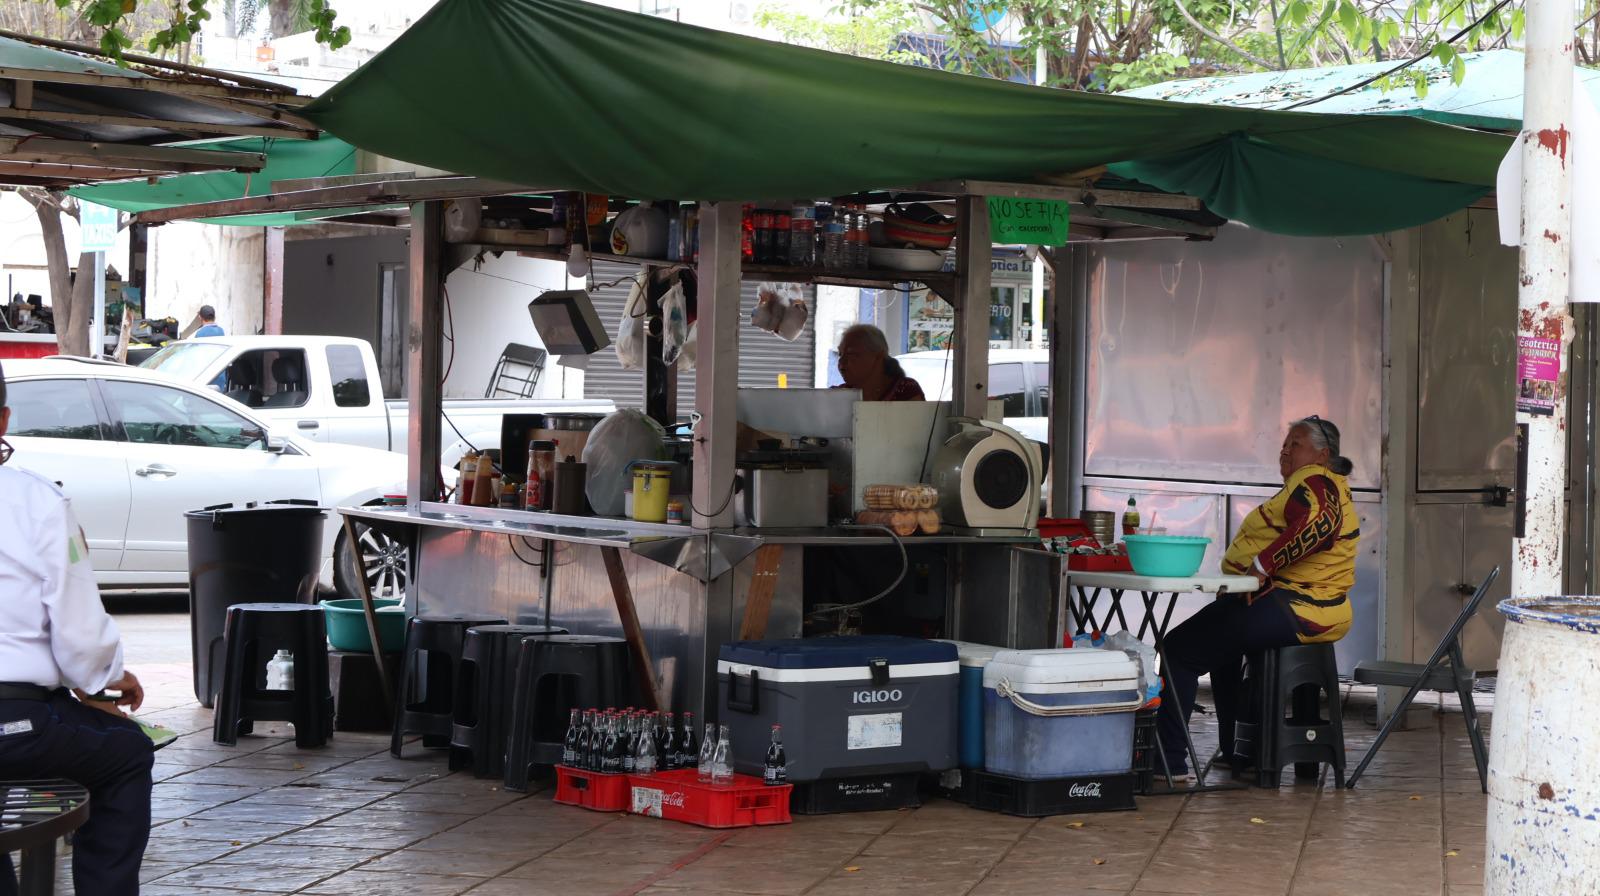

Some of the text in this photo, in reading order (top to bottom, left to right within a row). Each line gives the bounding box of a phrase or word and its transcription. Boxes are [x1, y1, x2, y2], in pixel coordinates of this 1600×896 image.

[989, 199, 1011, 219] NO
[1015, 201, 1032, 219] SE
[853, 689, 902, 704] IGLOO
